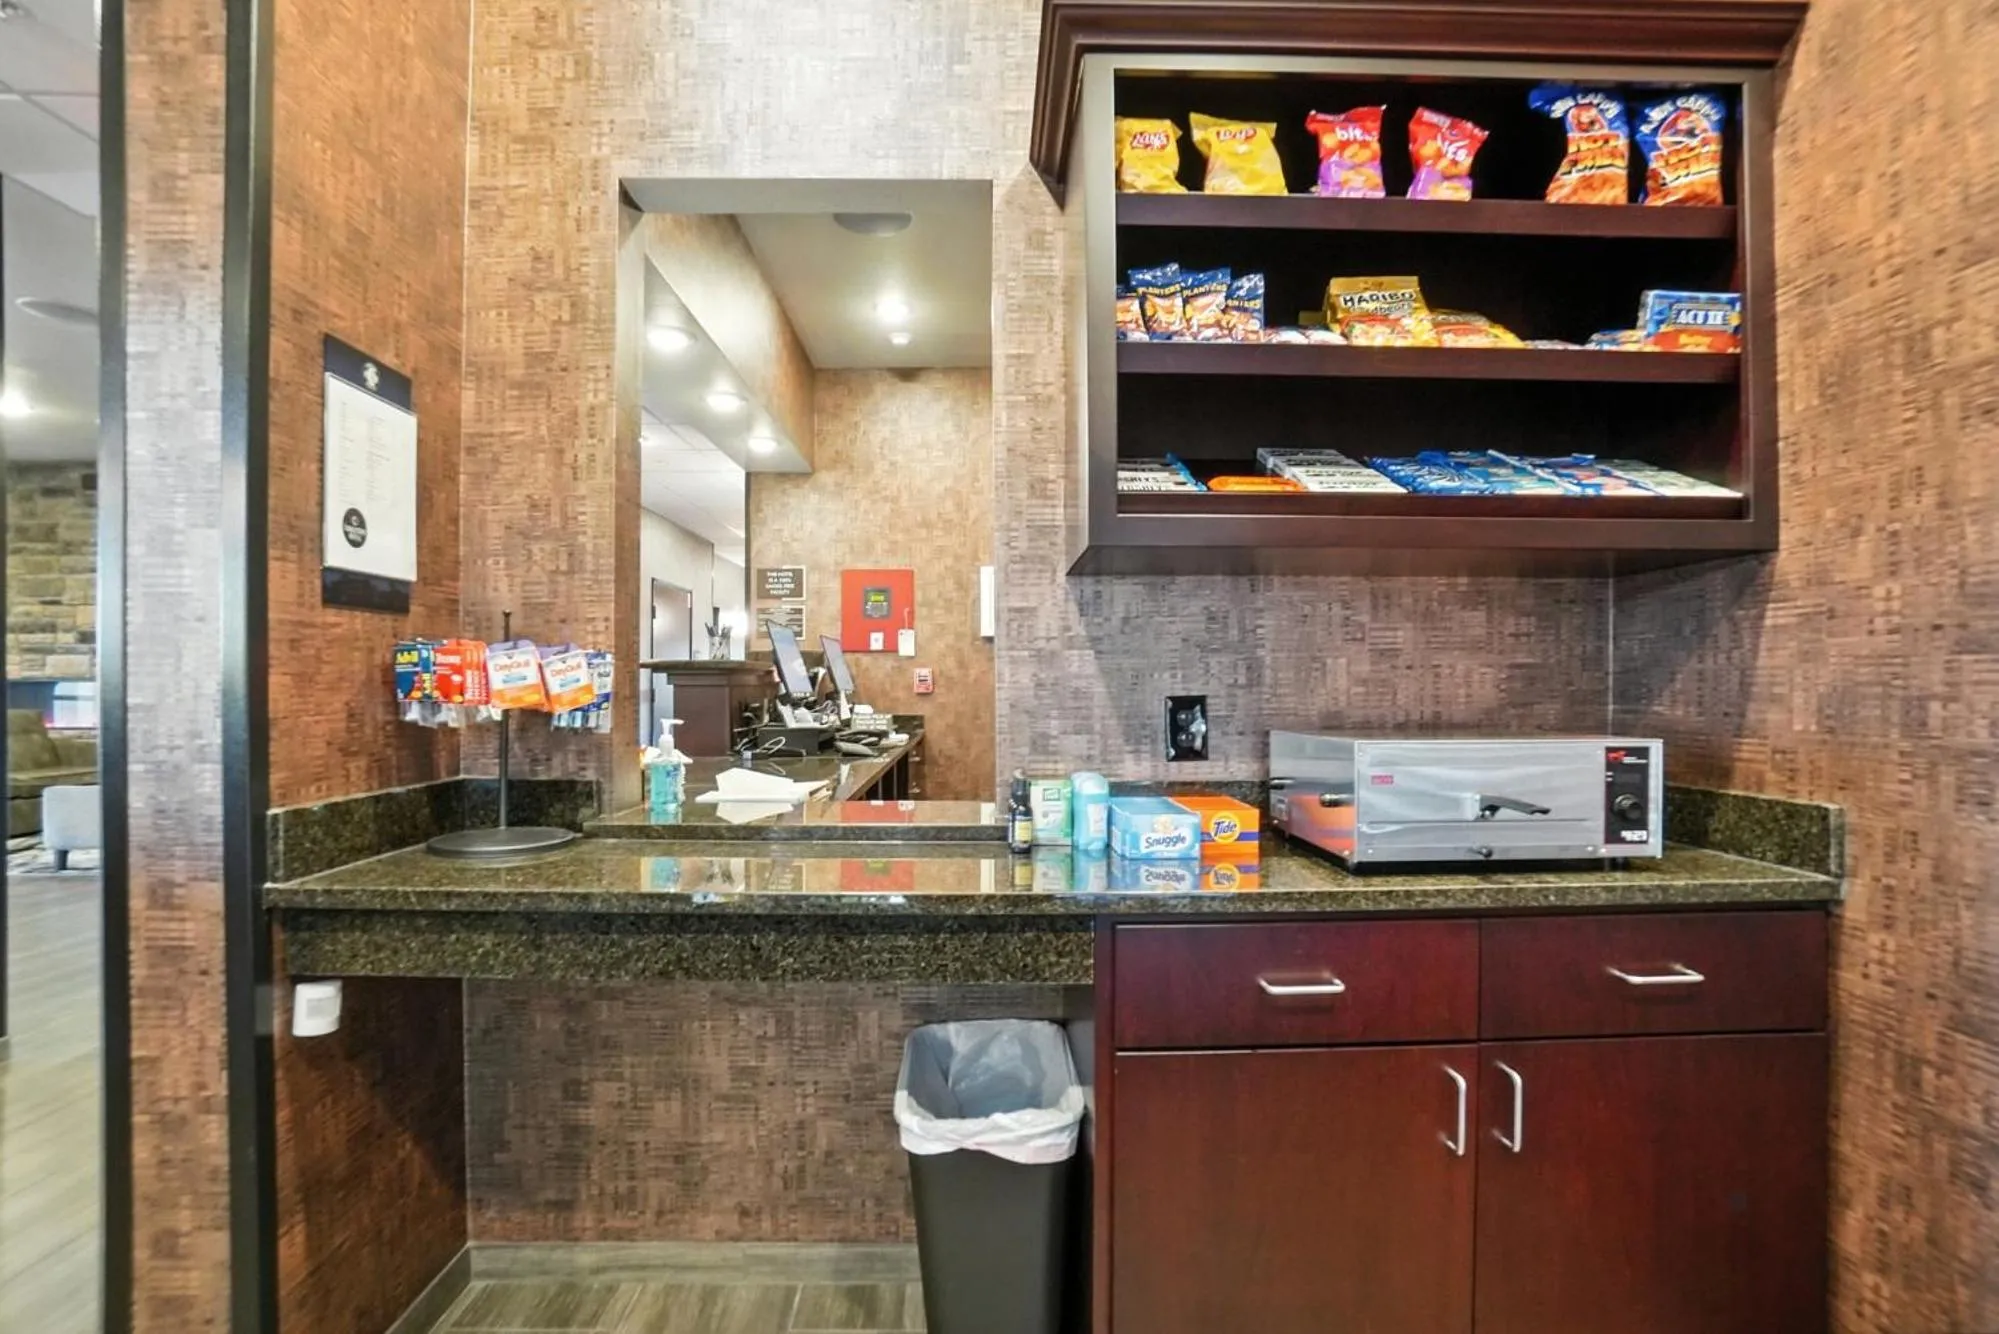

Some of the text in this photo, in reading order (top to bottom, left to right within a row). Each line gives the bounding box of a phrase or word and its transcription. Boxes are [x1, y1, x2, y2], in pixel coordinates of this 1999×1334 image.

[1130, 130, 1169, 150] Lay's
[1182, 283, 1228, 298] PLANTERS
[1343, 291, 1414, 307] HARIBO
[1213, 820, 1237, 837] Tide
[1144, 833, 1187, 849] Snuggle
